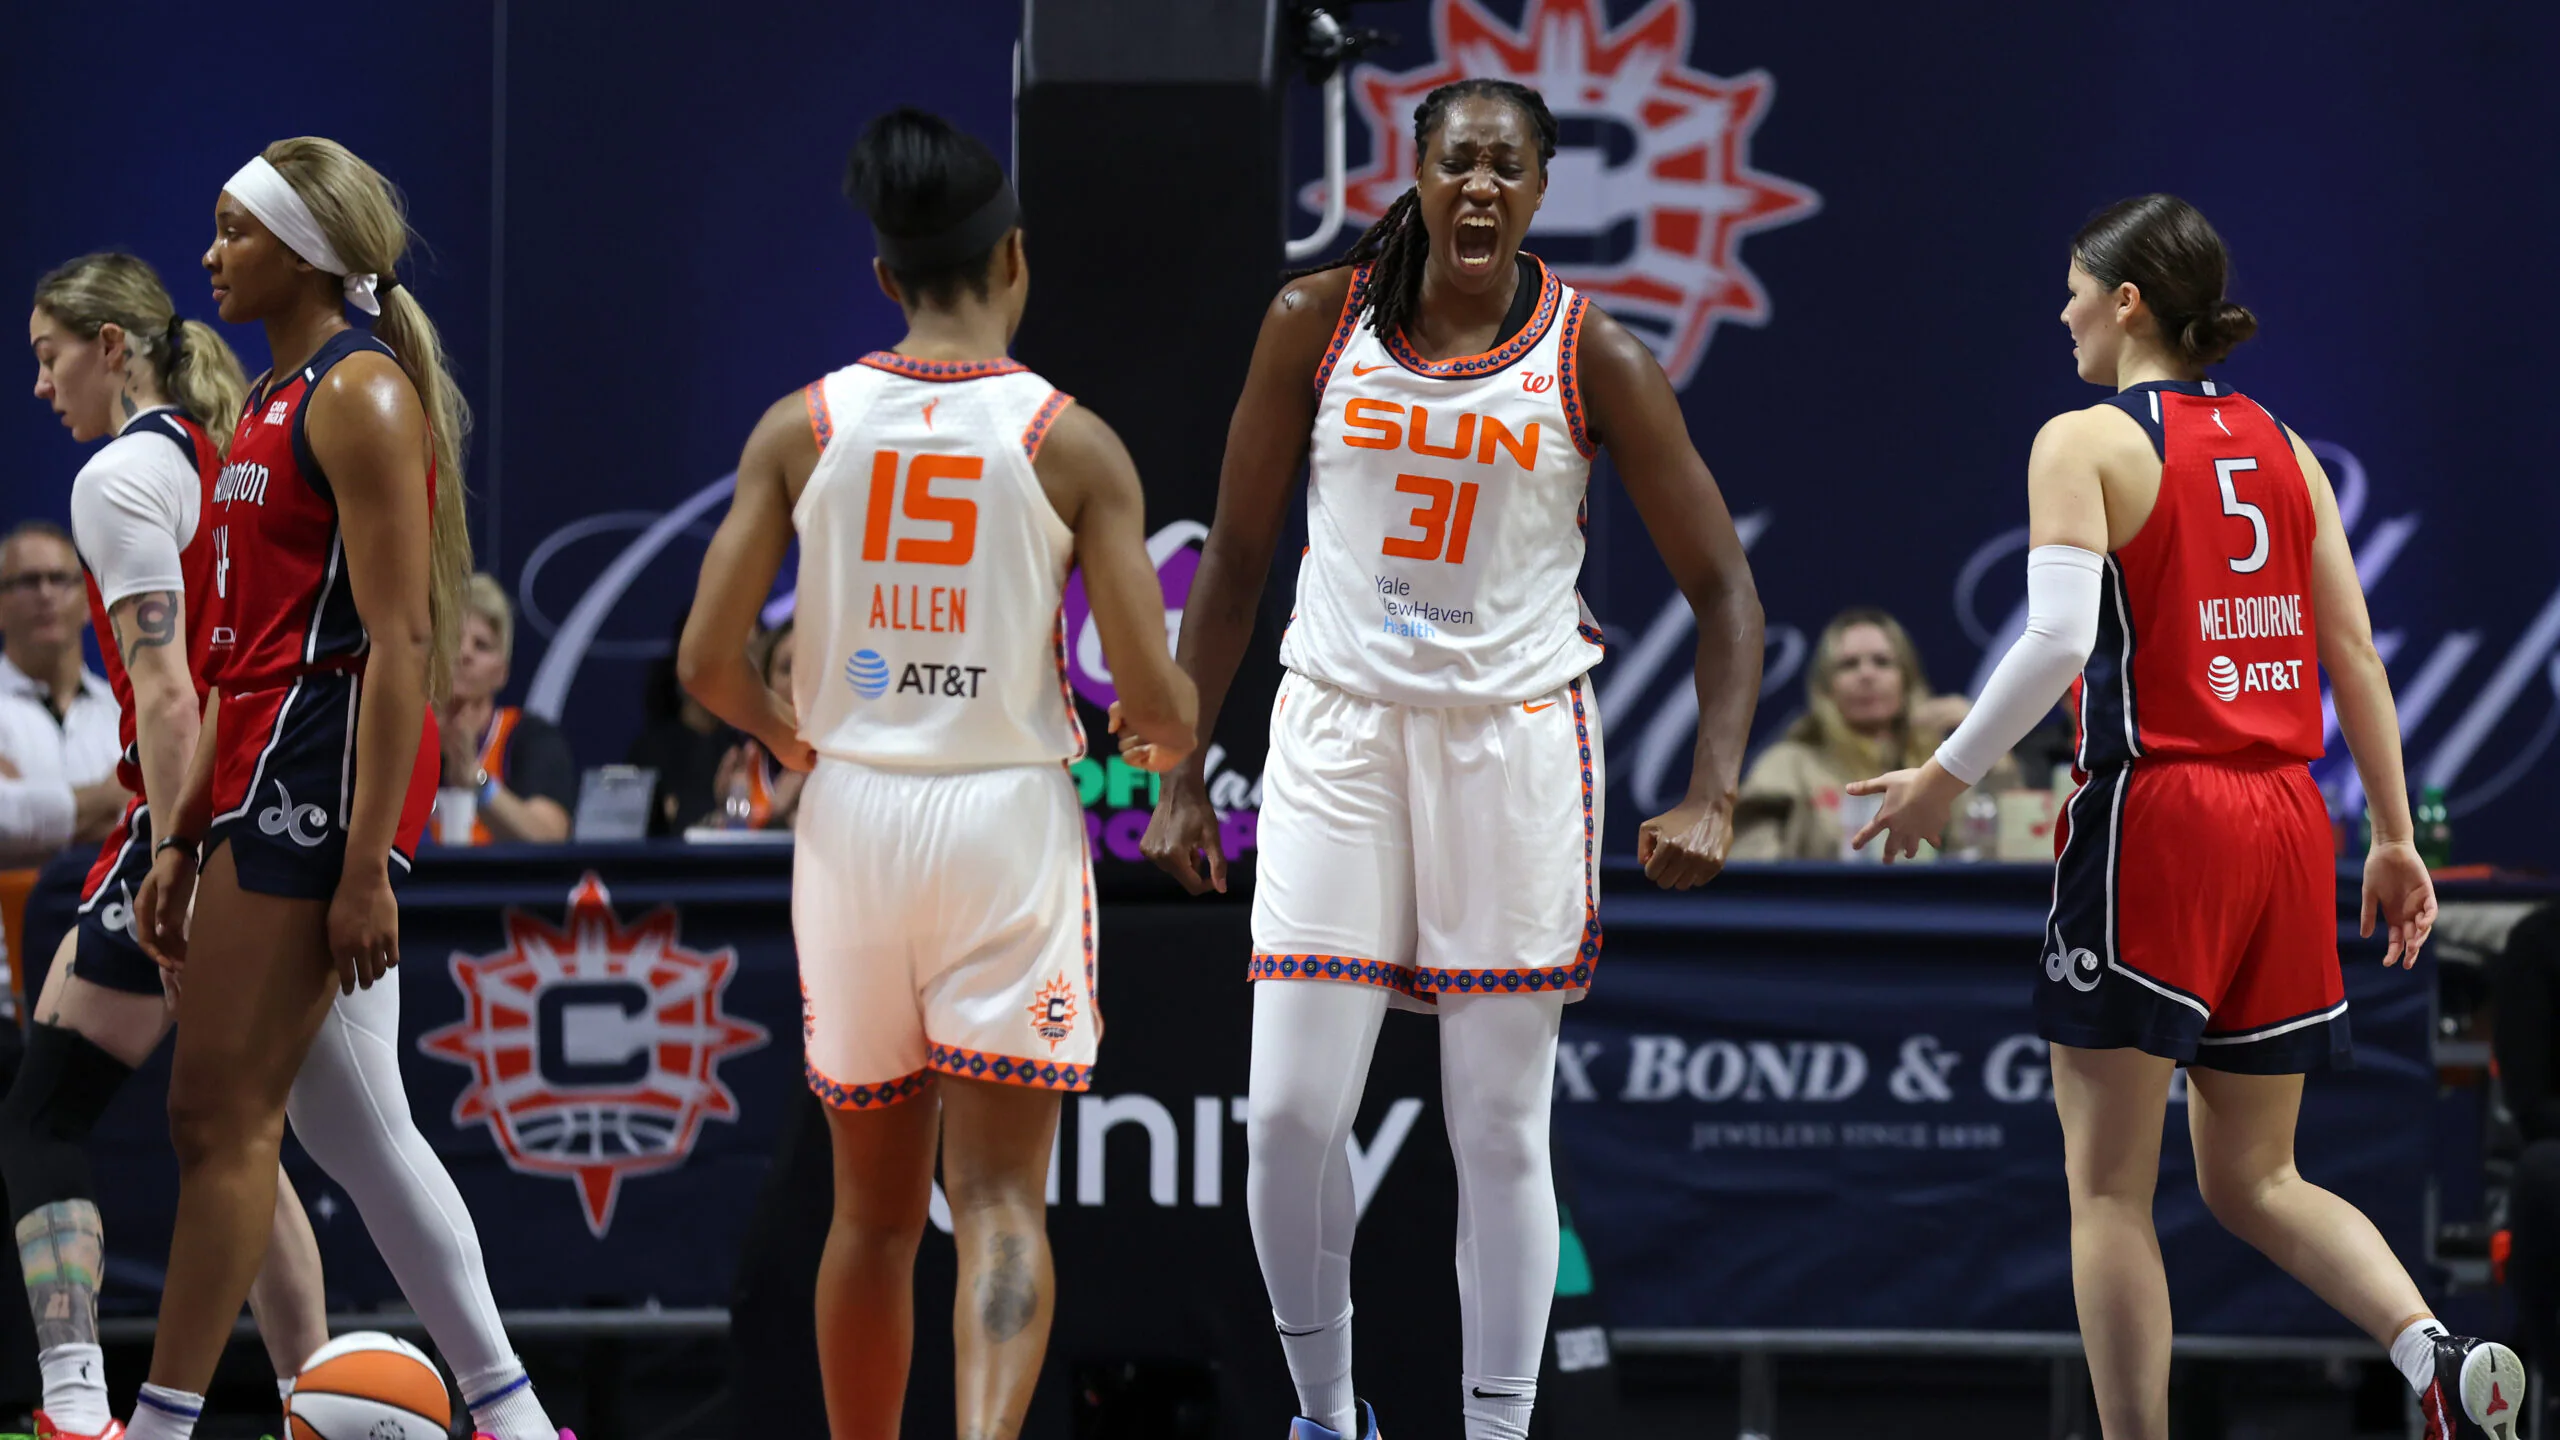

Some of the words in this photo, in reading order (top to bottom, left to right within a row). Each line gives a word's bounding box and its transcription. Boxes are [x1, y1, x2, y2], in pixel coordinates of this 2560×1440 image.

[1342, 398, 1540, 471] SUN
[861, 450, 984, 567] 15
[1382, 473, 1479, 564] 31
[2213, 457, 2270, 574] 5
[868, 583, 967, 634] ALLEN
[1375, 575, 1410, 597] Yale
[2199, 594, 2304, 641] MELBOURNE
[897, 663, 987, 698] AT&T
[2244, 659, 2303, 692] AT&T
[1621, 1034, 1869, 1102] BOND
[1889, 1034, 1960, 1102] &
